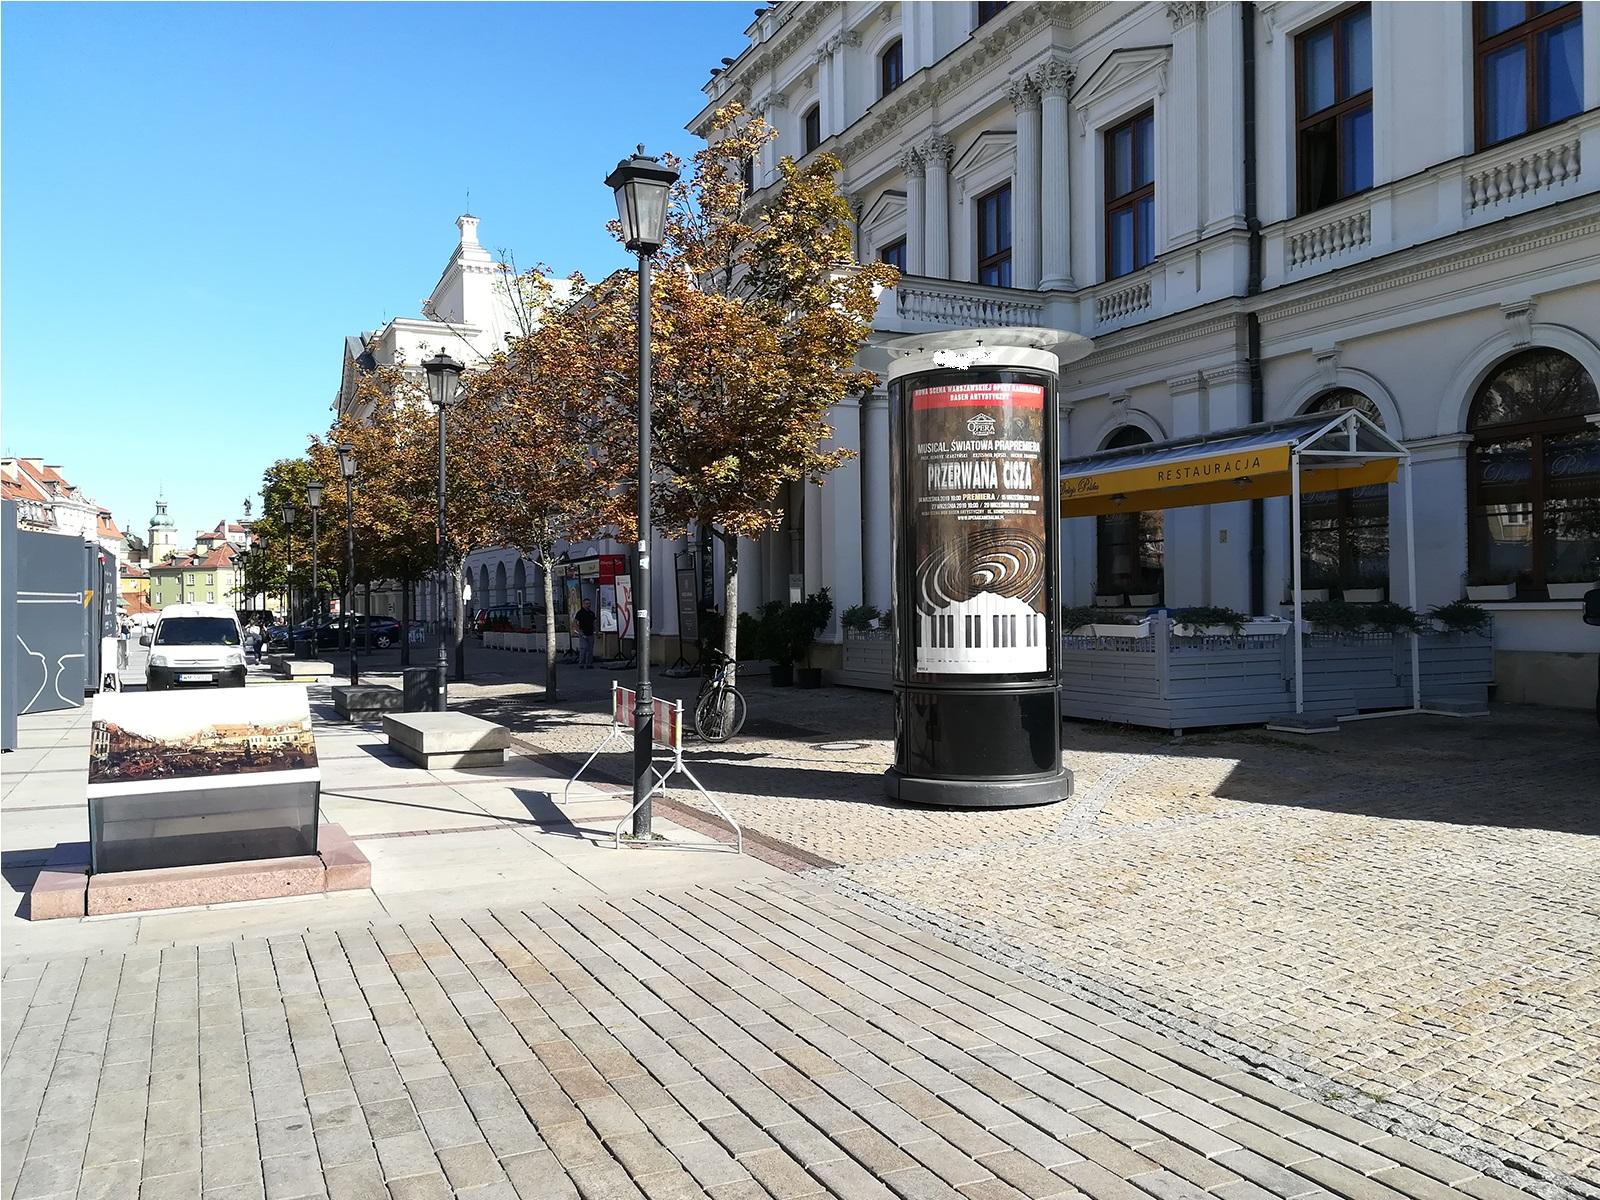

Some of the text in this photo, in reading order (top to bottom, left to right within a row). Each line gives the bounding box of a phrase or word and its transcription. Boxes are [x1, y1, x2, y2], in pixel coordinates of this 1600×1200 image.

[951, 440, 993, 452] ŚWIATOWA
[928, 460, 998, 490] PRZERWANA
[1003, 460, 1032, 490] CISZA
[1158, 457, 1260, 480] RESTAURACJA
[962, 492, 995, 500] PREMIERA
